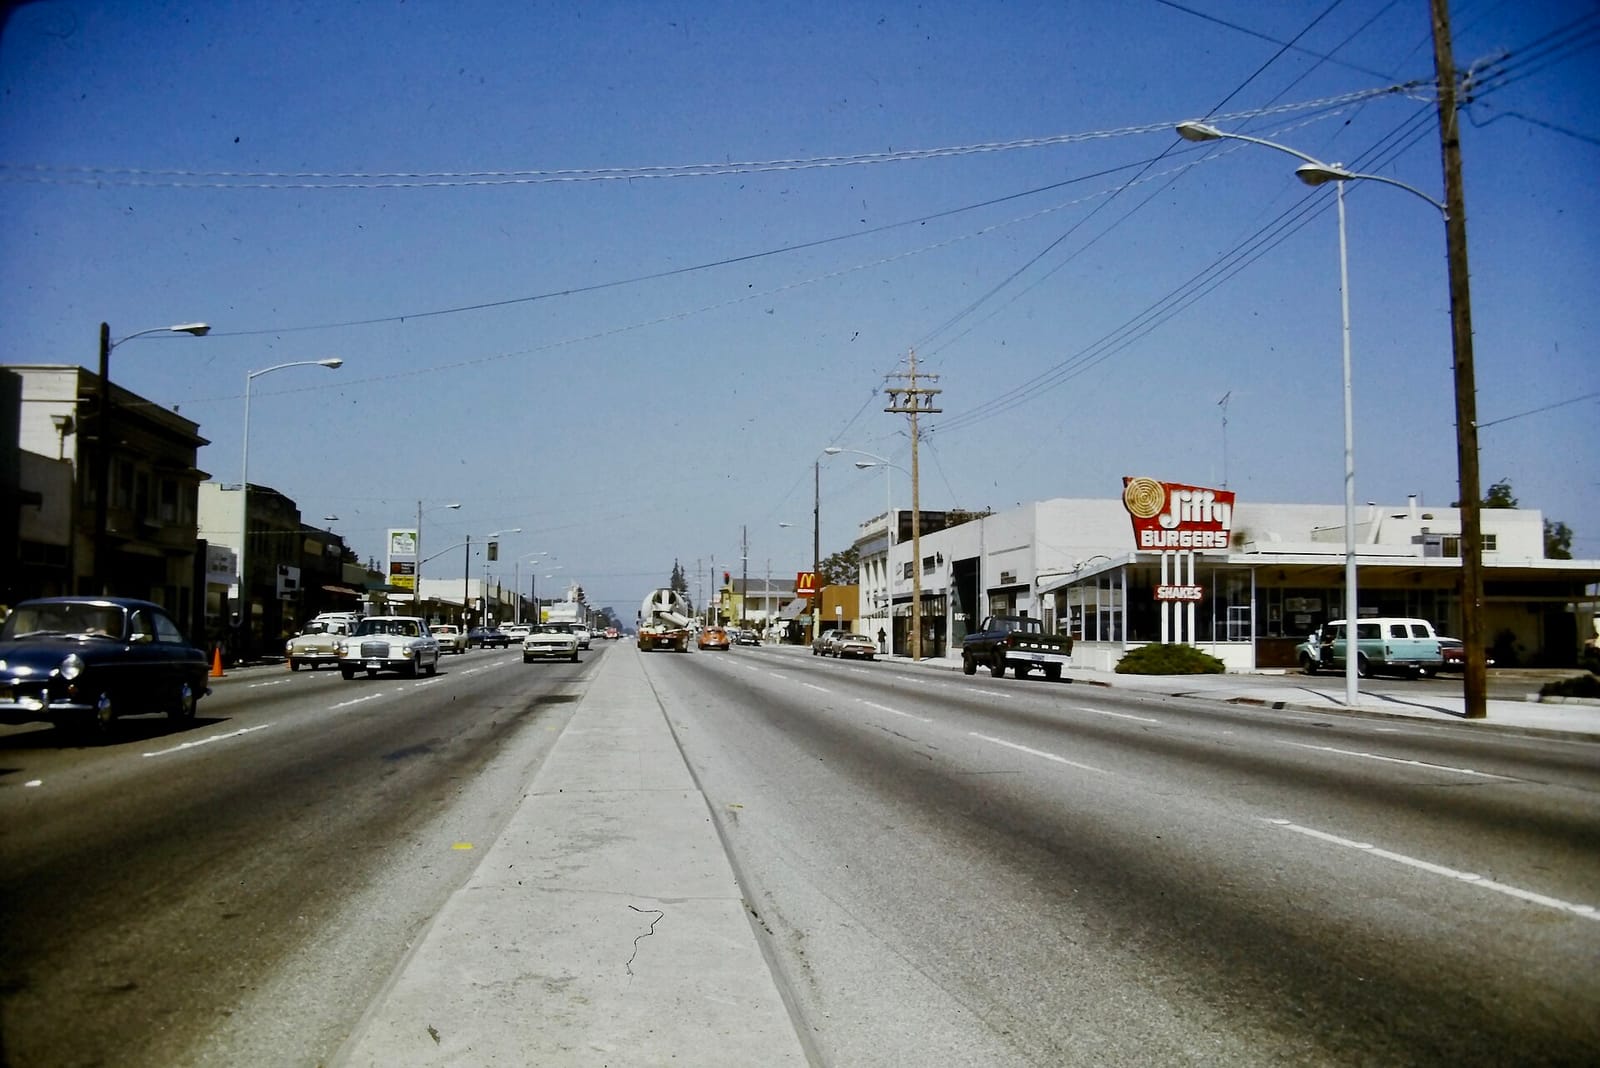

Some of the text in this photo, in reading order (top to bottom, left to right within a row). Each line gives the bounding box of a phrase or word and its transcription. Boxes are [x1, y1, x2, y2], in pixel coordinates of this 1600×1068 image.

[1158, 489, 1231, 530] Jiffy
[1140, 530, 1229, 548] BURGERS
[1157, 586, 1202, 600] SHAKES
[1019, 642, 1060, 650] FORD
